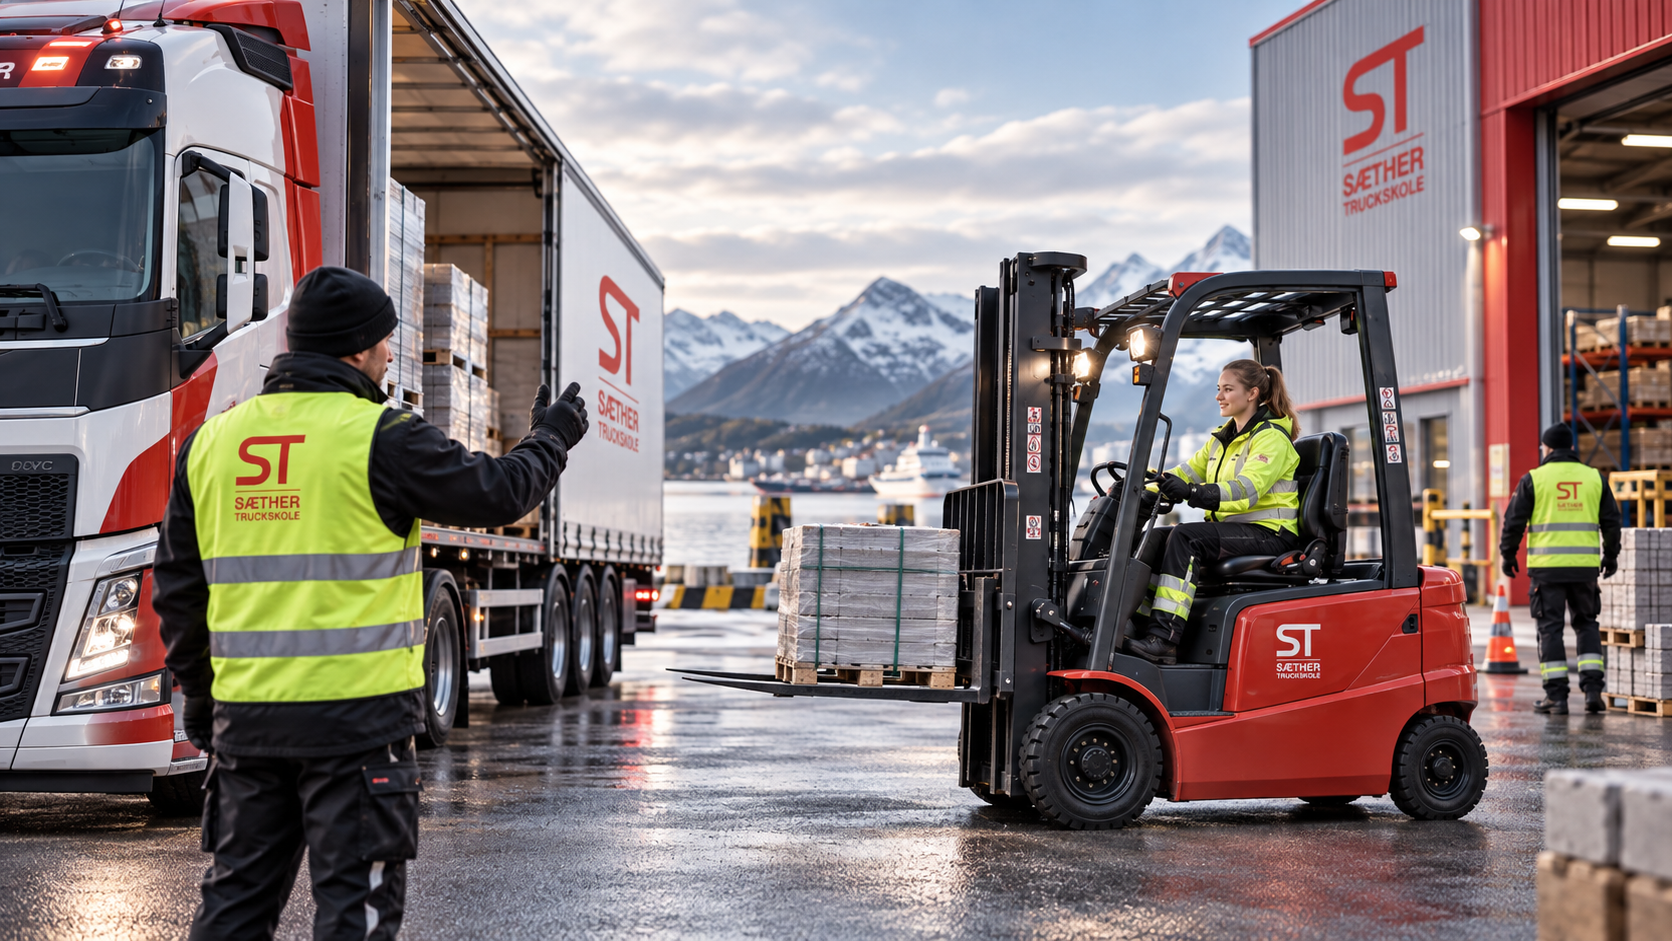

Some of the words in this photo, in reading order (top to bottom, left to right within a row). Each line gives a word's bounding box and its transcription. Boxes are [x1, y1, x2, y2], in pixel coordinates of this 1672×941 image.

[1343, 24, 1425, 156] ST
[1343, 146, 1425, 197] SÆTHER
[1343, 175, 1425, 217] TRUCKSKOLE
[598, 274, 640, 387] ST
[598, 389, 639, 433] SÆTHER
[235, 434, 306, 487] ST
[234, 495, 301, 511] SÆTHER
[1556, 481, 1583, 500] ST
[234, 511, 301, 522] TRUCKSKOLE
[1276, 623, 1321, 657] ST
[1276, 662, 1321, 672] SÆTHER
